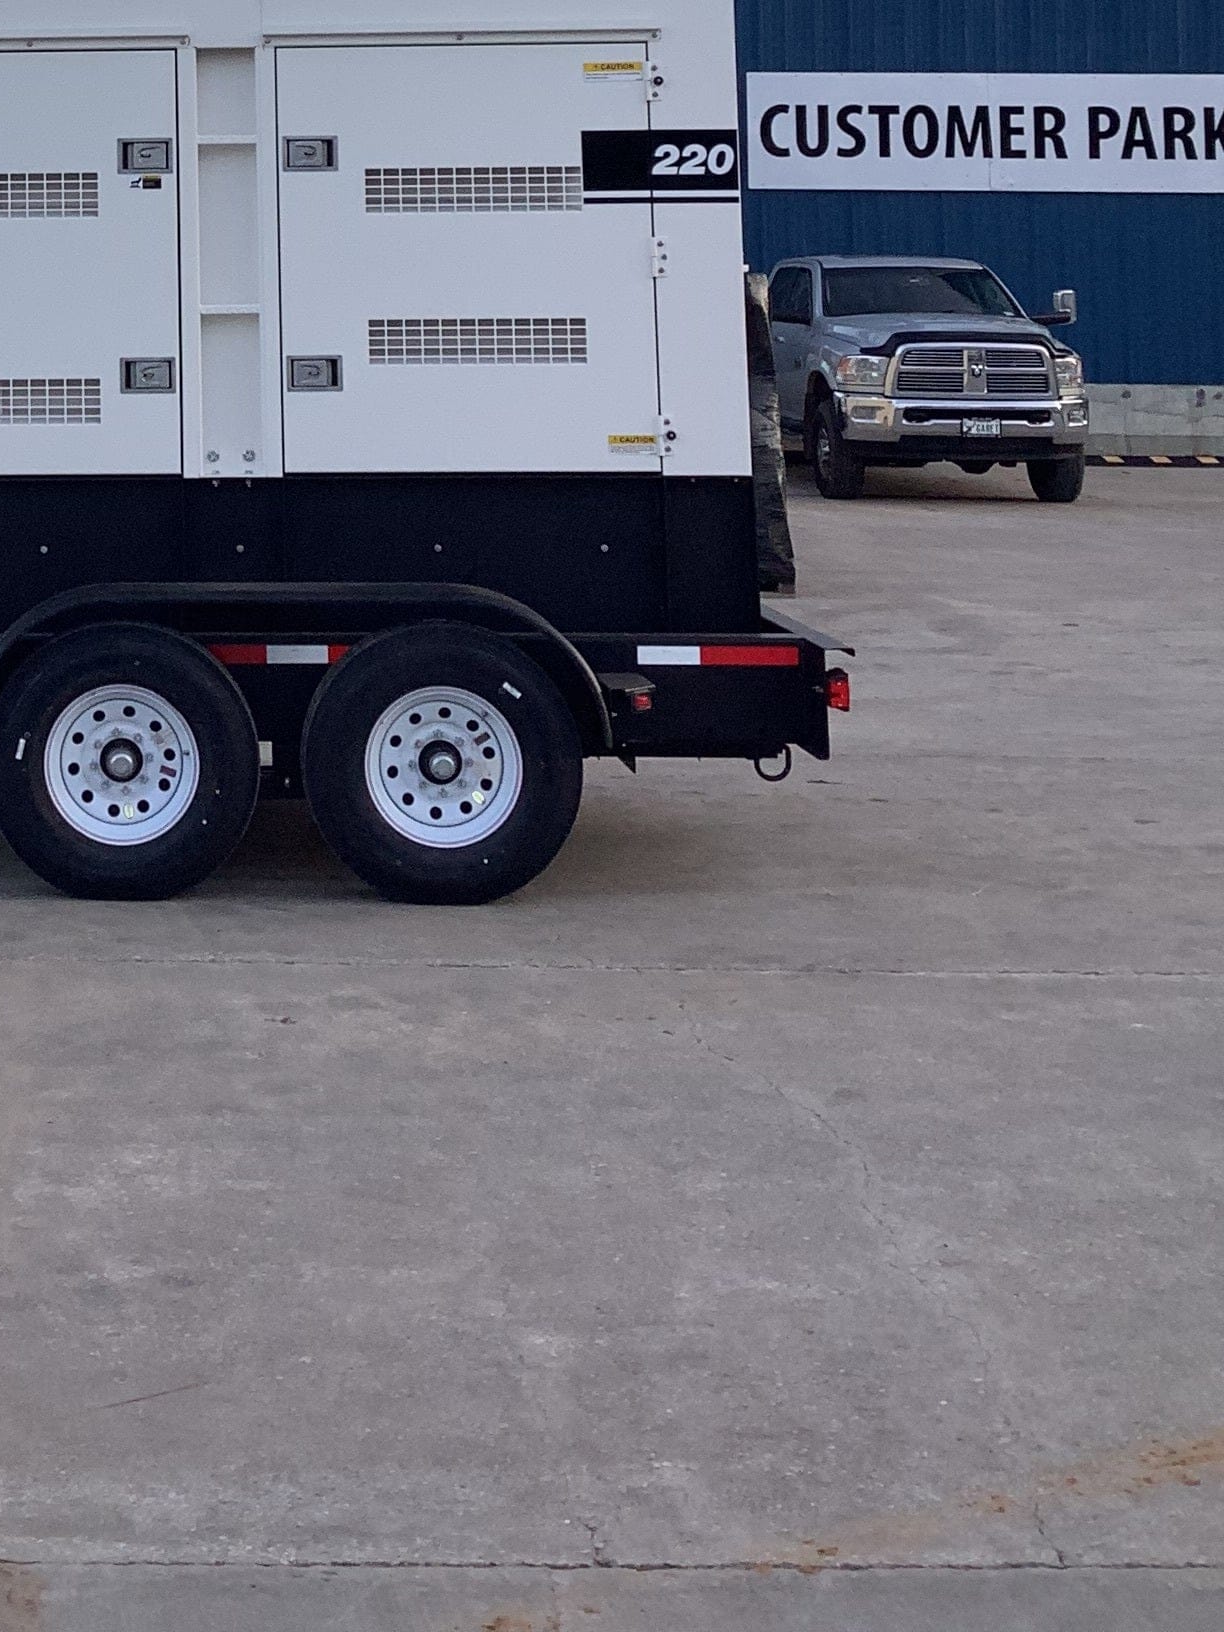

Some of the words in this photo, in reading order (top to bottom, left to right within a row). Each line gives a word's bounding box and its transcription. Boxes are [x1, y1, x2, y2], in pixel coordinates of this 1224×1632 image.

[759, 103, 1068, 159] CUSTOMER
[1088, 106, 1224, 161] PARK
[652, 143, 735, 176] 220
